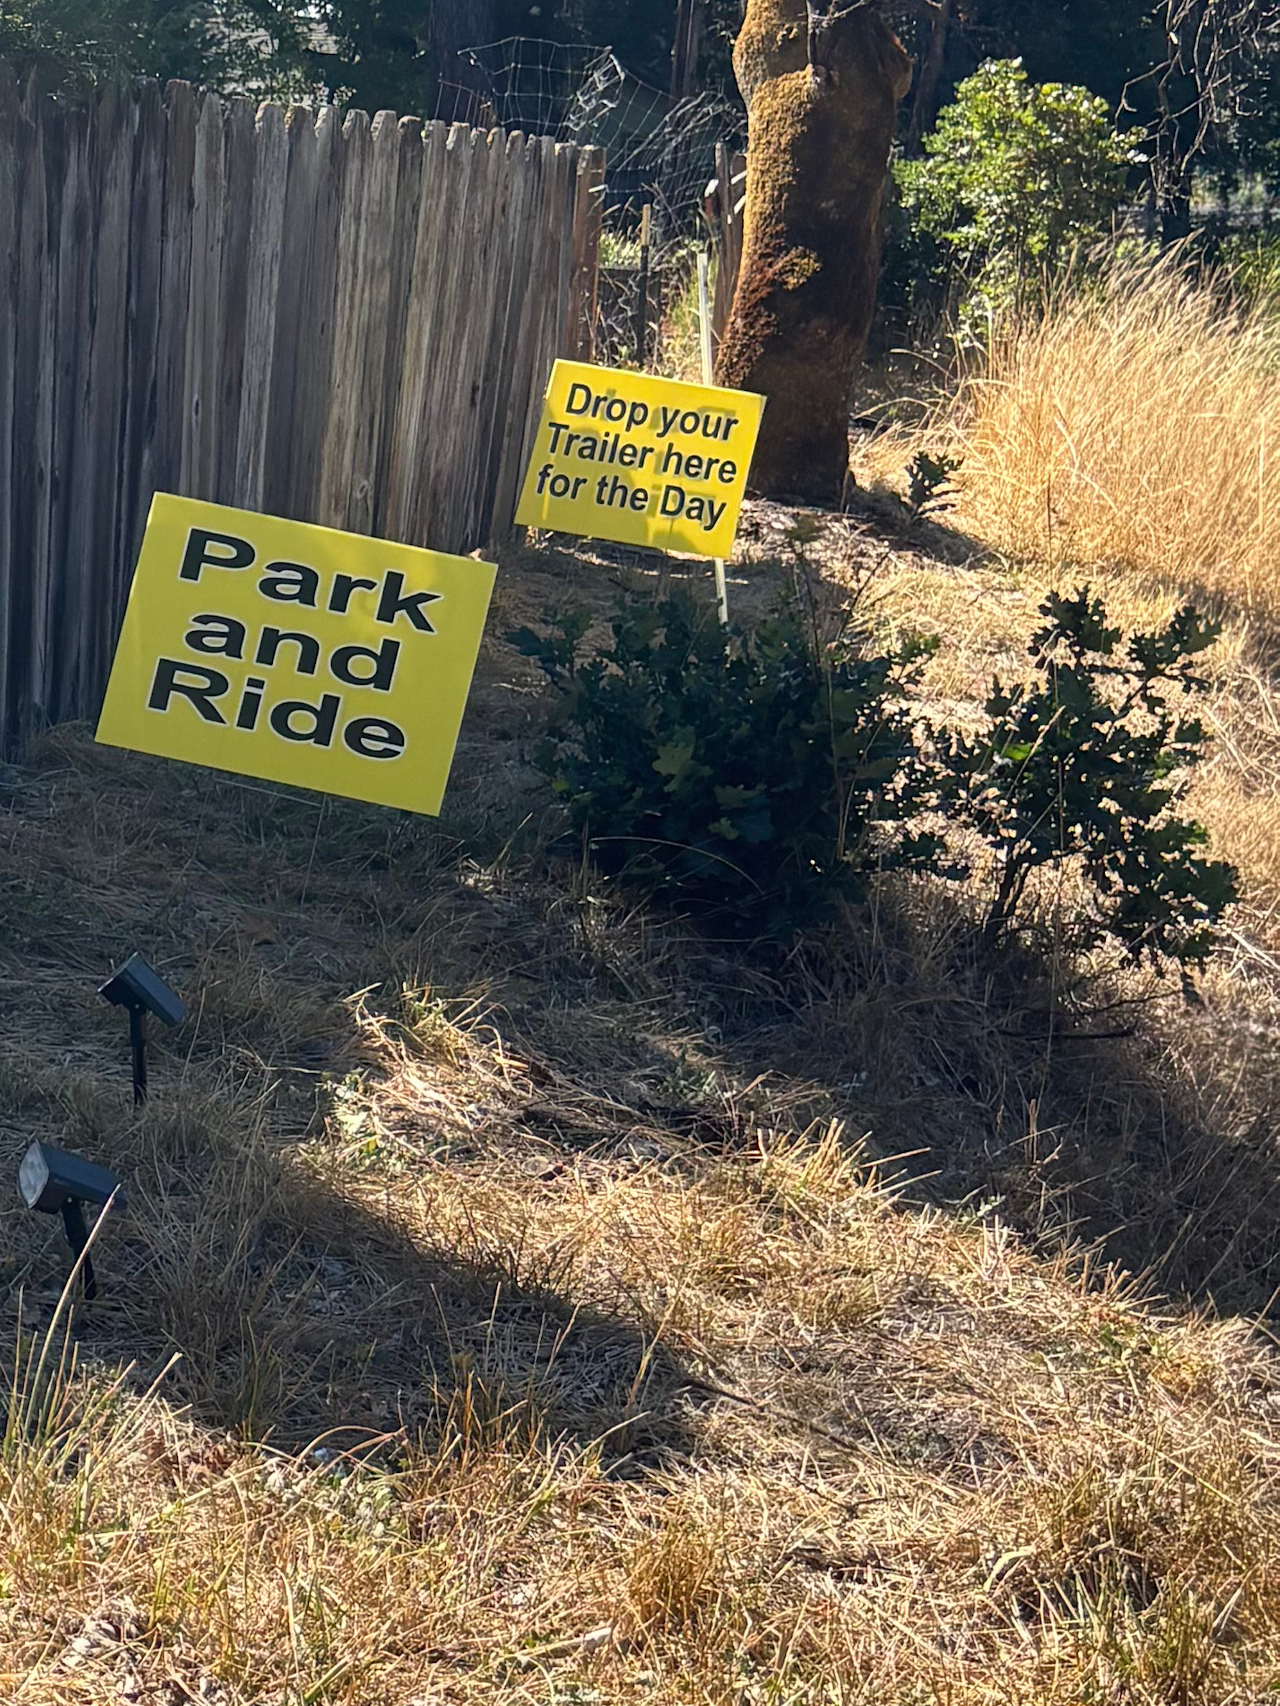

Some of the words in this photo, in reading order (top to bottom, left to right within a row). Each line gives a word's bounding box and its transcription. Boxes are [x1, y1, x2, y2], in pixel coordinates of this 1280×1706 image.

[565, 383, 649, 432] Drop
[656, 406, 739, 441] your
[548, 421, 655, 468] Trailer
[662, 442, 738, 484] here
[536, 463, 588, 500] for
[596, 475, 649, 511] the
[660, 484, 727, 531] Day
[179, 528, 441, 633] Park
[185, 612, 401, 692] and
[148, 658, 405, 759] Ride
